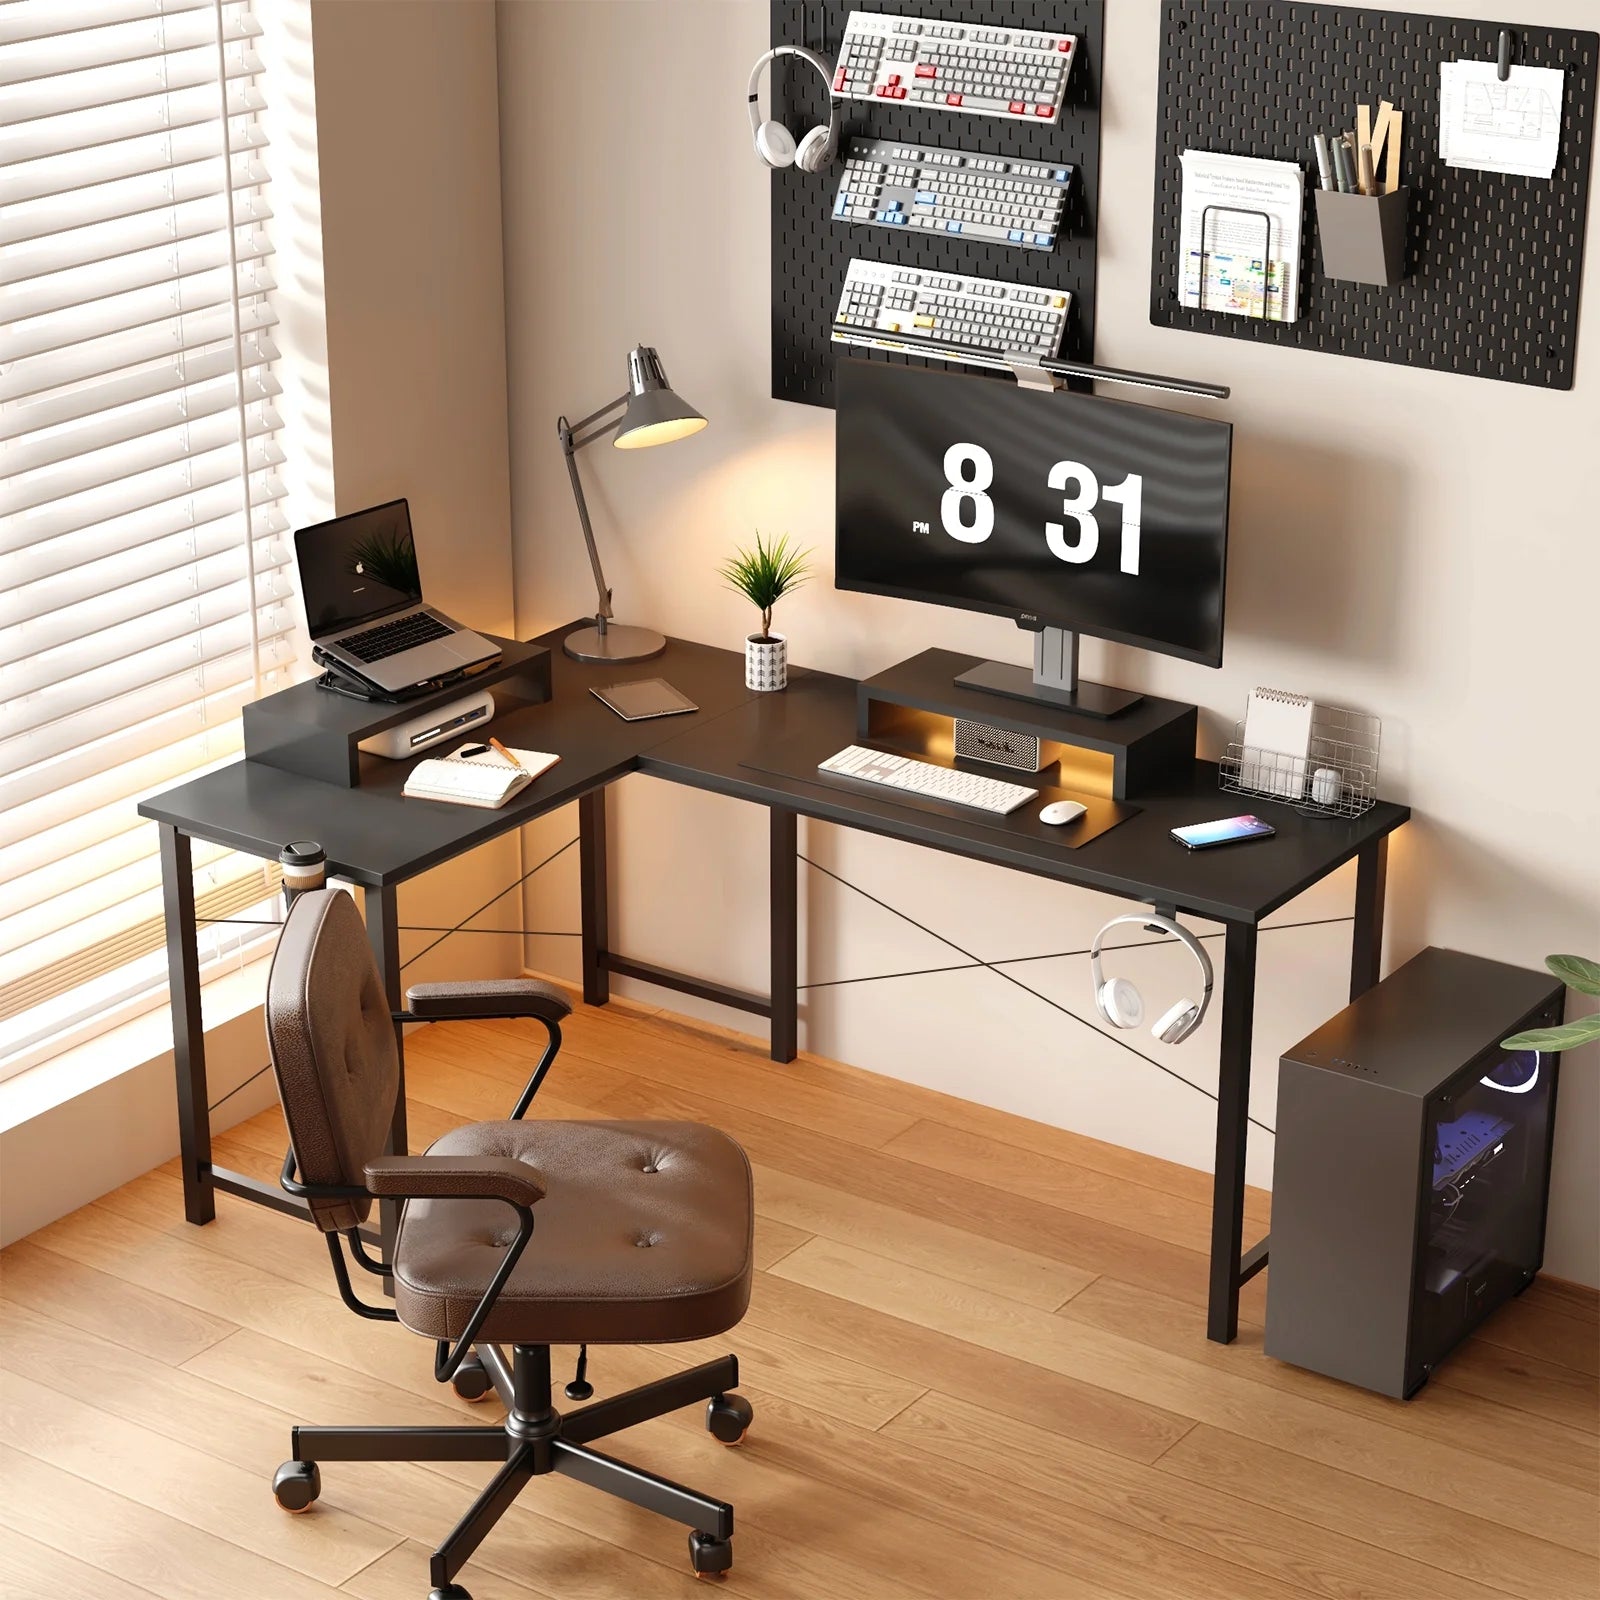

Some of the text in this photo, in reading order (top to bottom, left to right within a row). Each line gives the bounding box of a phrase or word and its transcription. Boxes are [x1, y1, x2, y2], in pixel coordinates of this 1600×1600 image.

[912, 442, 1143, 576] PM 8 31
